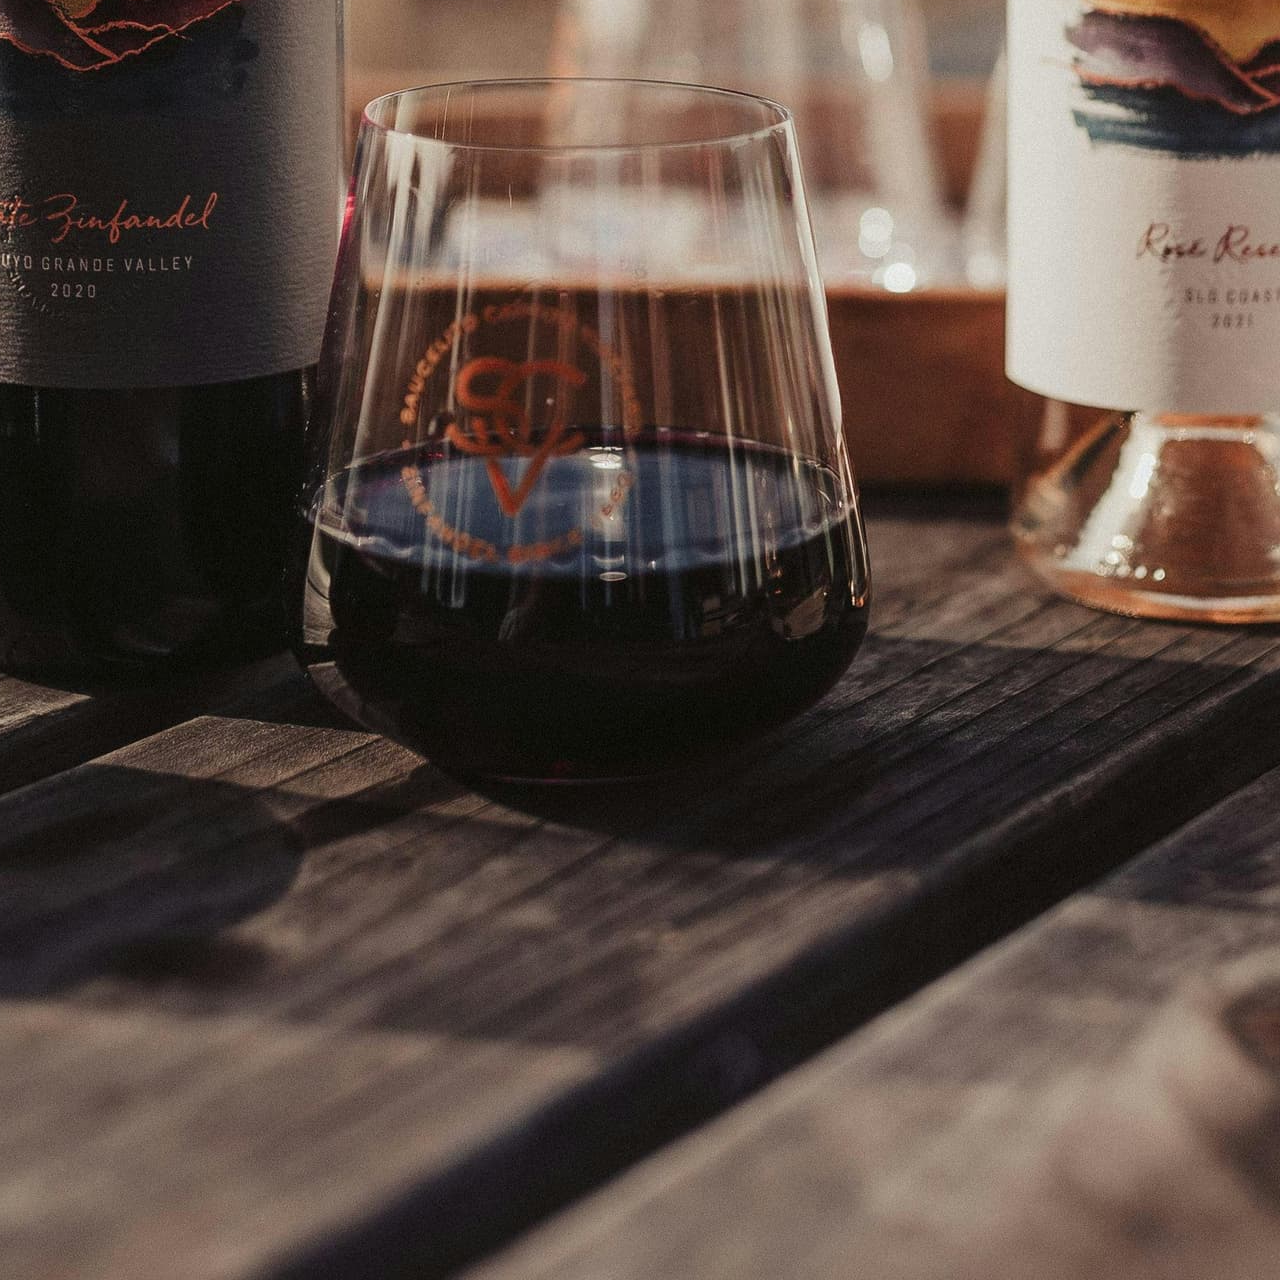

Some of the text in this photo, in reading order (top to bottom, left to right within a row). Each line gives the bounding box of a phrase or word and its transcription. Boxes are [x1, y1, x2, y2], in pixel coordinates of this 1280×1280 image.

[44, 191, 219, 244] Zinfandel
[41, 255, 115, 273] GRANDE
[123, 255, 194, 272] VALLEY
[50, 282, 97, 299] 2020
